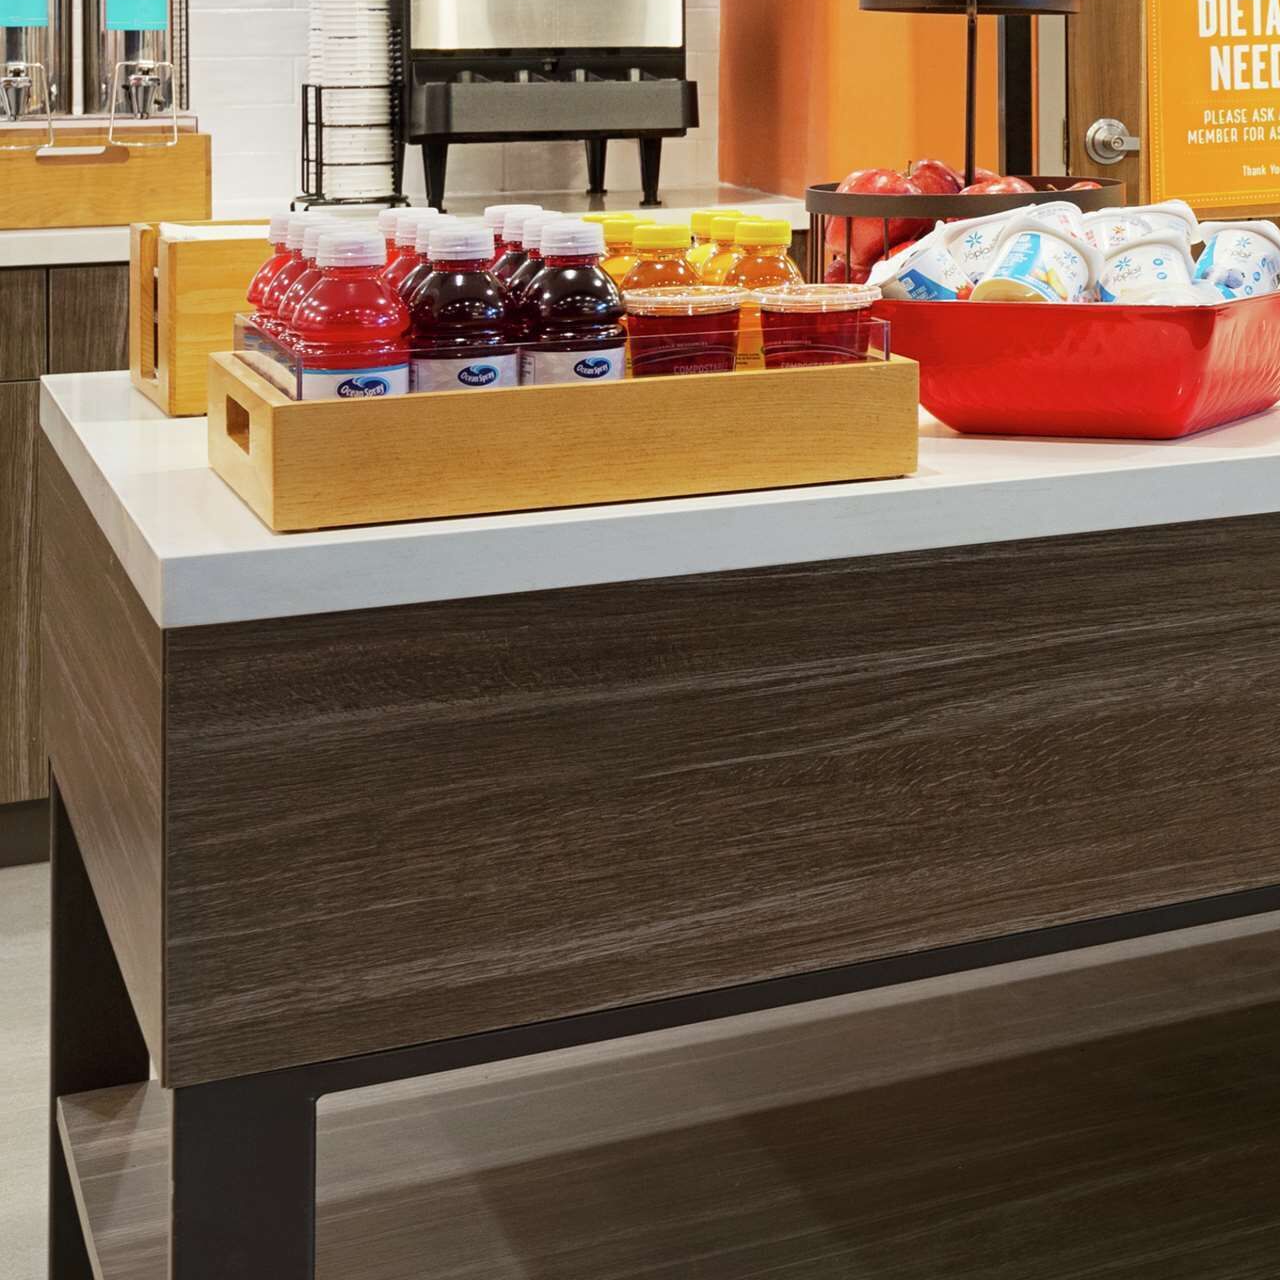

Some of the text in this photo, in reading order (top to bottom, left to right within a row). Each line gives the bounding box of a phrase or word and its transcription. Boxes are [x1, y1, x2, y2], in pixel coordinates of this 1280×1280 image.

[1203, 108, 1248, 125] PLEASE
[1252, 107, 1274, 123] ASK
[1187, 127, 1238, 145] MEMBER
[1243, 126, 1265, 142] FOR
[1242, 163, 1267, 177] Thank
